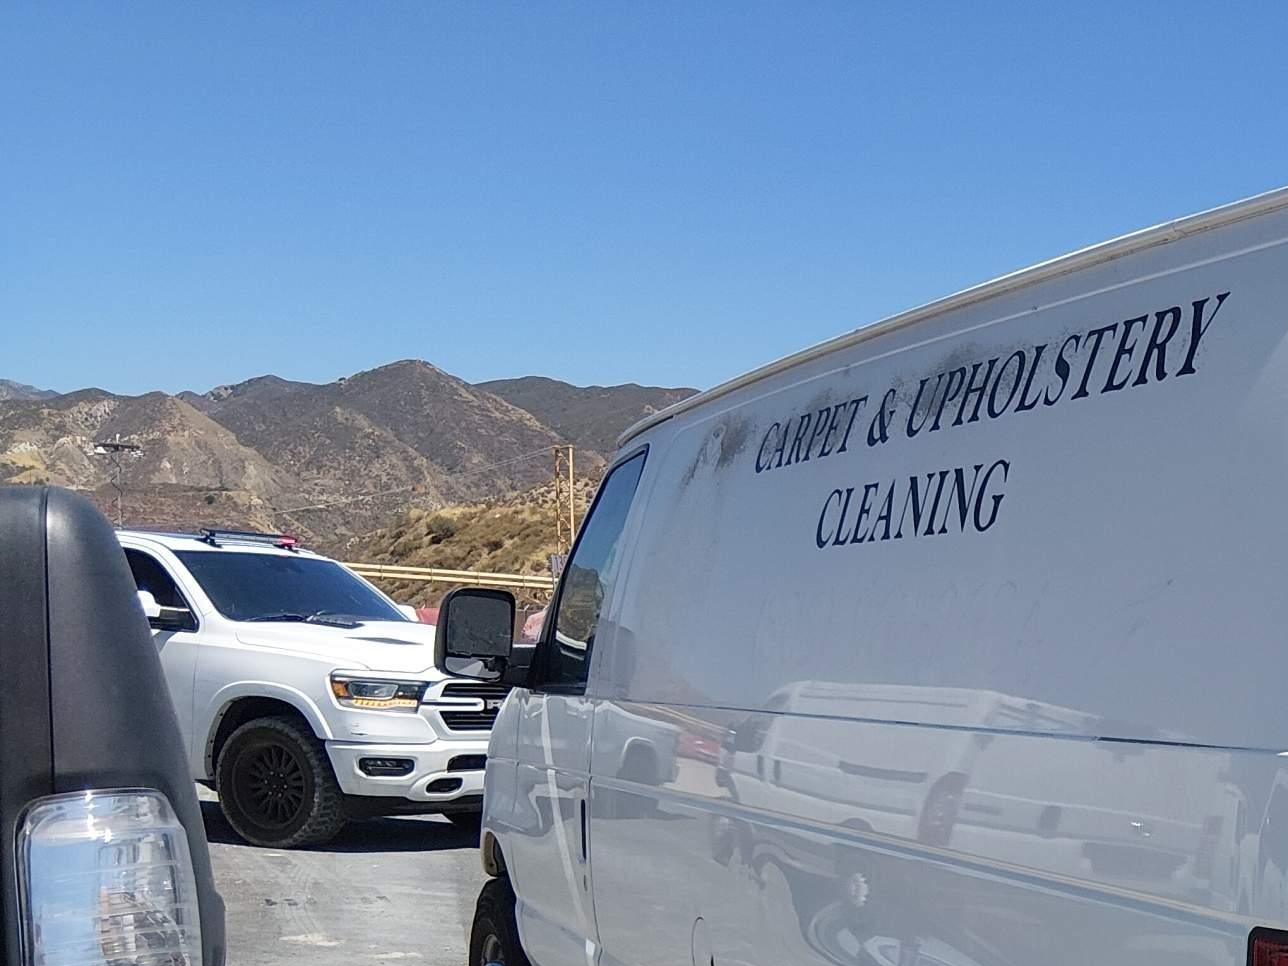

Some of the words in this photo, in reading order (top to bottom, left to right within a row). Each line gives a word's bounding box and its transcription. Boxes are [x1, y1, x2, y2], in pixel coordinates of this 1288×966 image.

[755, 395, 869, 474] CARPET
[867, 388, 897, 447] &
[906, 291, 1231, 438] UPHOLSTERY
[815, 459, 1011, 549] CLEANING
